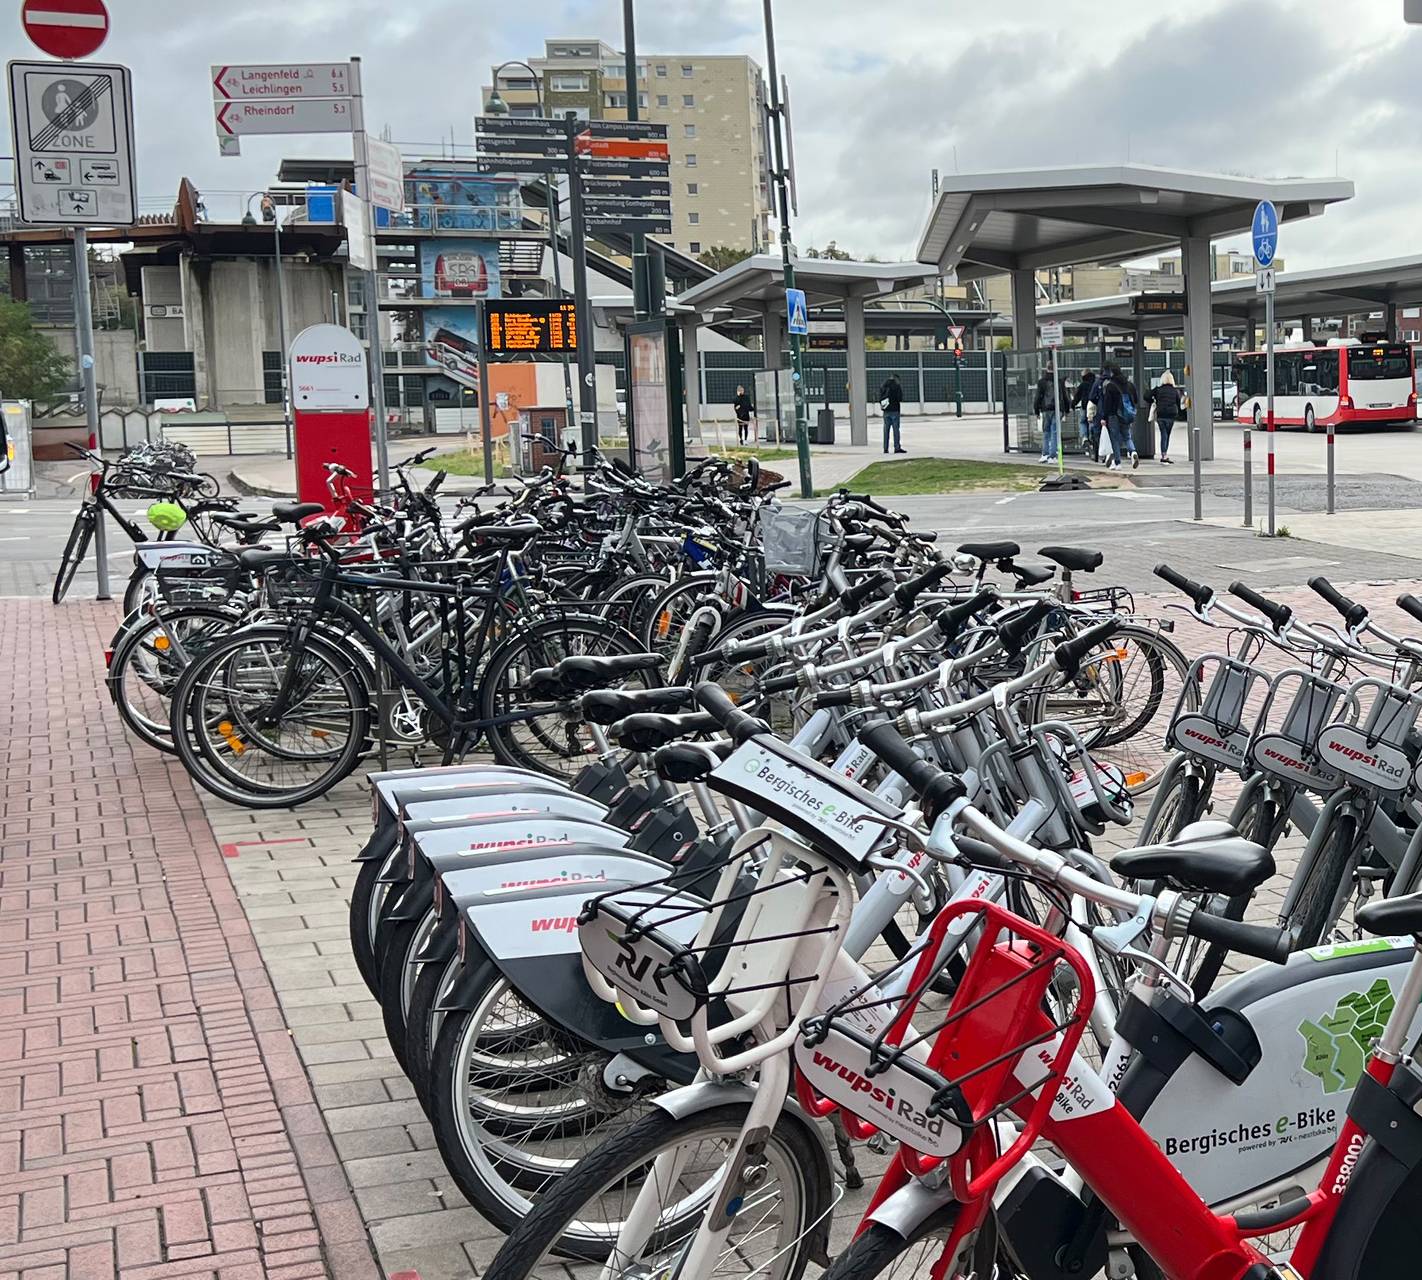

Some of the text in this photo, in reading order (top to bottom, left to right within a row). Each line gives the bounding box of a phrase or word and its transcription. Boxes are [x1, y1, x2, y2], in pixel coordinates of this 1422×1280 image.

[241, 69, 300, 82] Langenfeld
[242, 84, 302, 95] Leichlingen
[244, 105, 294, 115] Rheindorf
[52, 135, 95, 148] ZONE
[296, 351, 361, 365] wupsi Rad
[1184, 728, 1244, 757] wupsi Ra
[851, 748, 869, 770] Rad
[1264, 748, 1312, 773] wupsi
[1328, 740, 1379, 767] wupsi
[1377, 758, 1405, 778] Rad
[757, 766, 824, 811] Bergisches
[531, 917, 580, 933] wup
[1109, 1054, 1131, 1096] 2661
[812, 1051, 944, 1137] wupsi Rad
[1070, 1084, 1095, 1110] Rad
[1166, 1108, 1336, 1156] Bergisches e-Bike
[1238, 1141, 1267, 1154] powered
[1332, 1134, 1364, 1194] 338002
